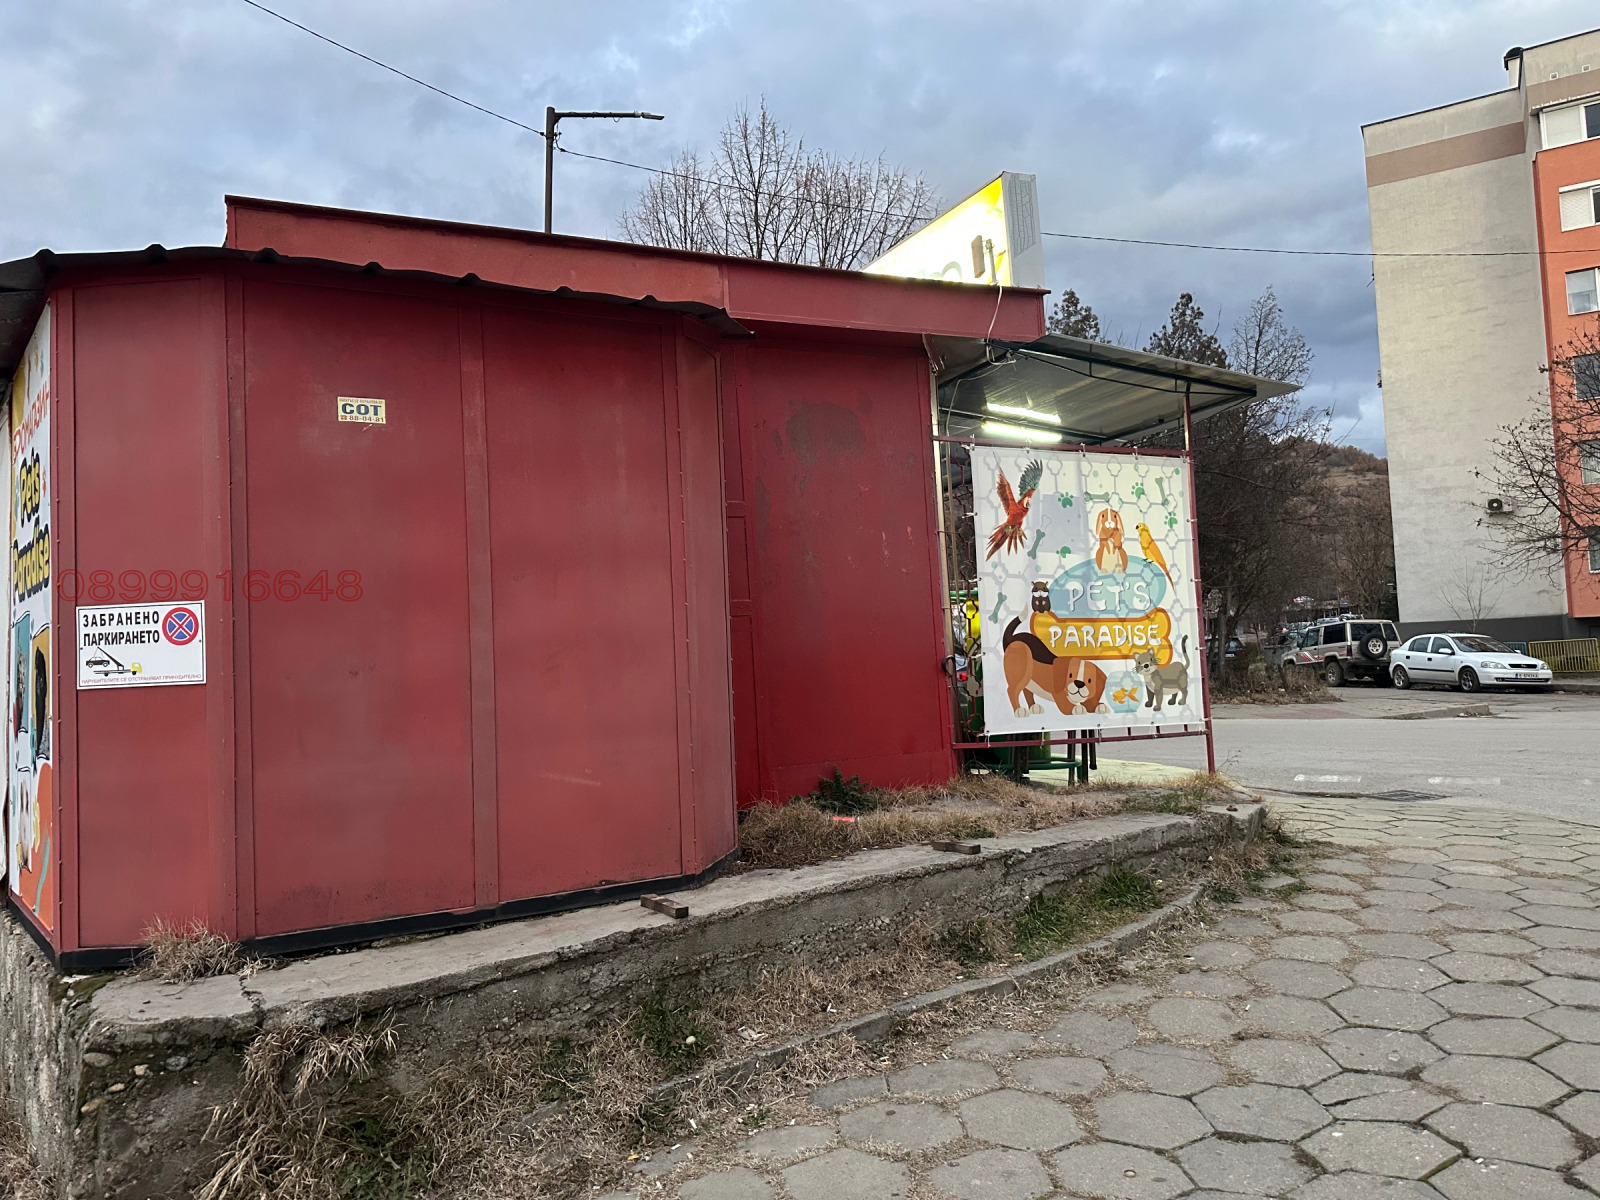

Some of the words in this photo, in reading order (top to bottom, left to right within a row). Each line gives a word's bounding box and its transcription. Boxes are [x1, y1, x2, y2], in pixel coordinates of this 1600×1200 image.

[341, 403, 382, 416] СОТ
[20, 446, 41, 528] Pets
[13, 515, 51, 606] Paradise
[1065, 581, 1152, 612] PET'S
[82, 610, 160, 628] ЗАБРАНЕНО
[82, 629, 160, 647] ПАРКИРАНЕТО
[1048, 624, 1162, 648] PARADISE
